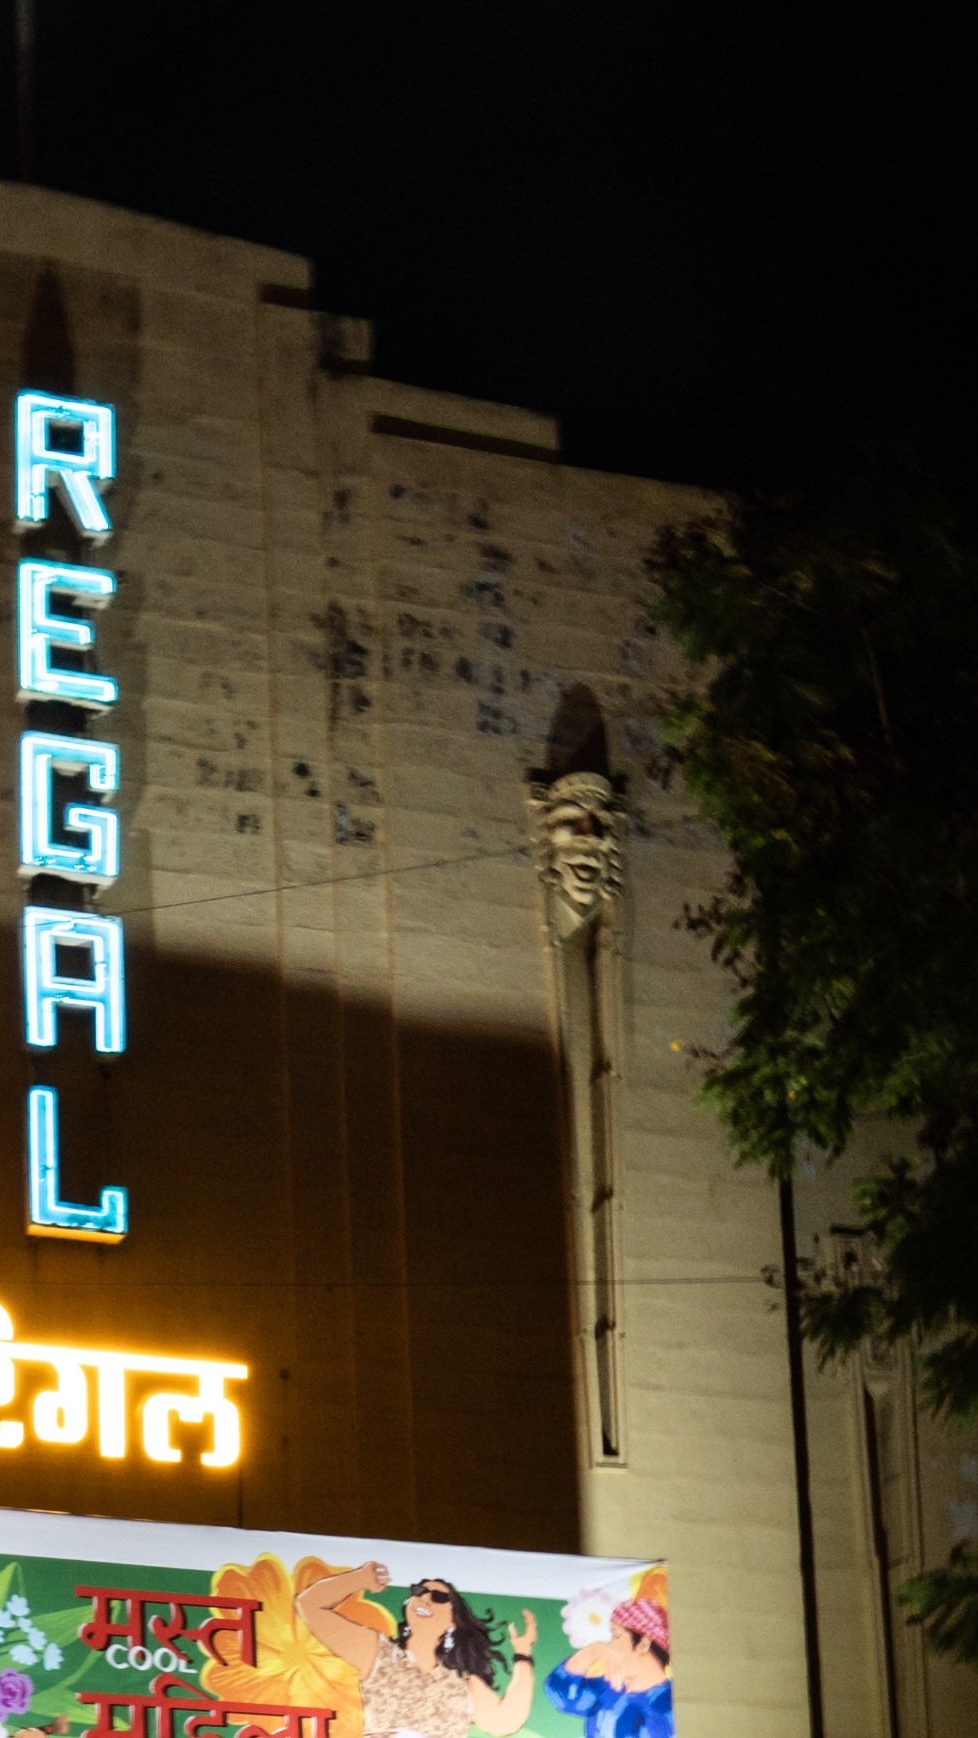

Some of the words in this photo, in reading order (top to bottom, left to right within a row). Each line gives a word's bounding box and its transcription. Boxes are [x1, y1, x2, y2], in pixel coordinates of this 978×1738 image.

[16, 390, 127, 1240] REGAL
[74, 1585, 262, 1667] मस्त
[105, 1643, 199, 1674] COOL
